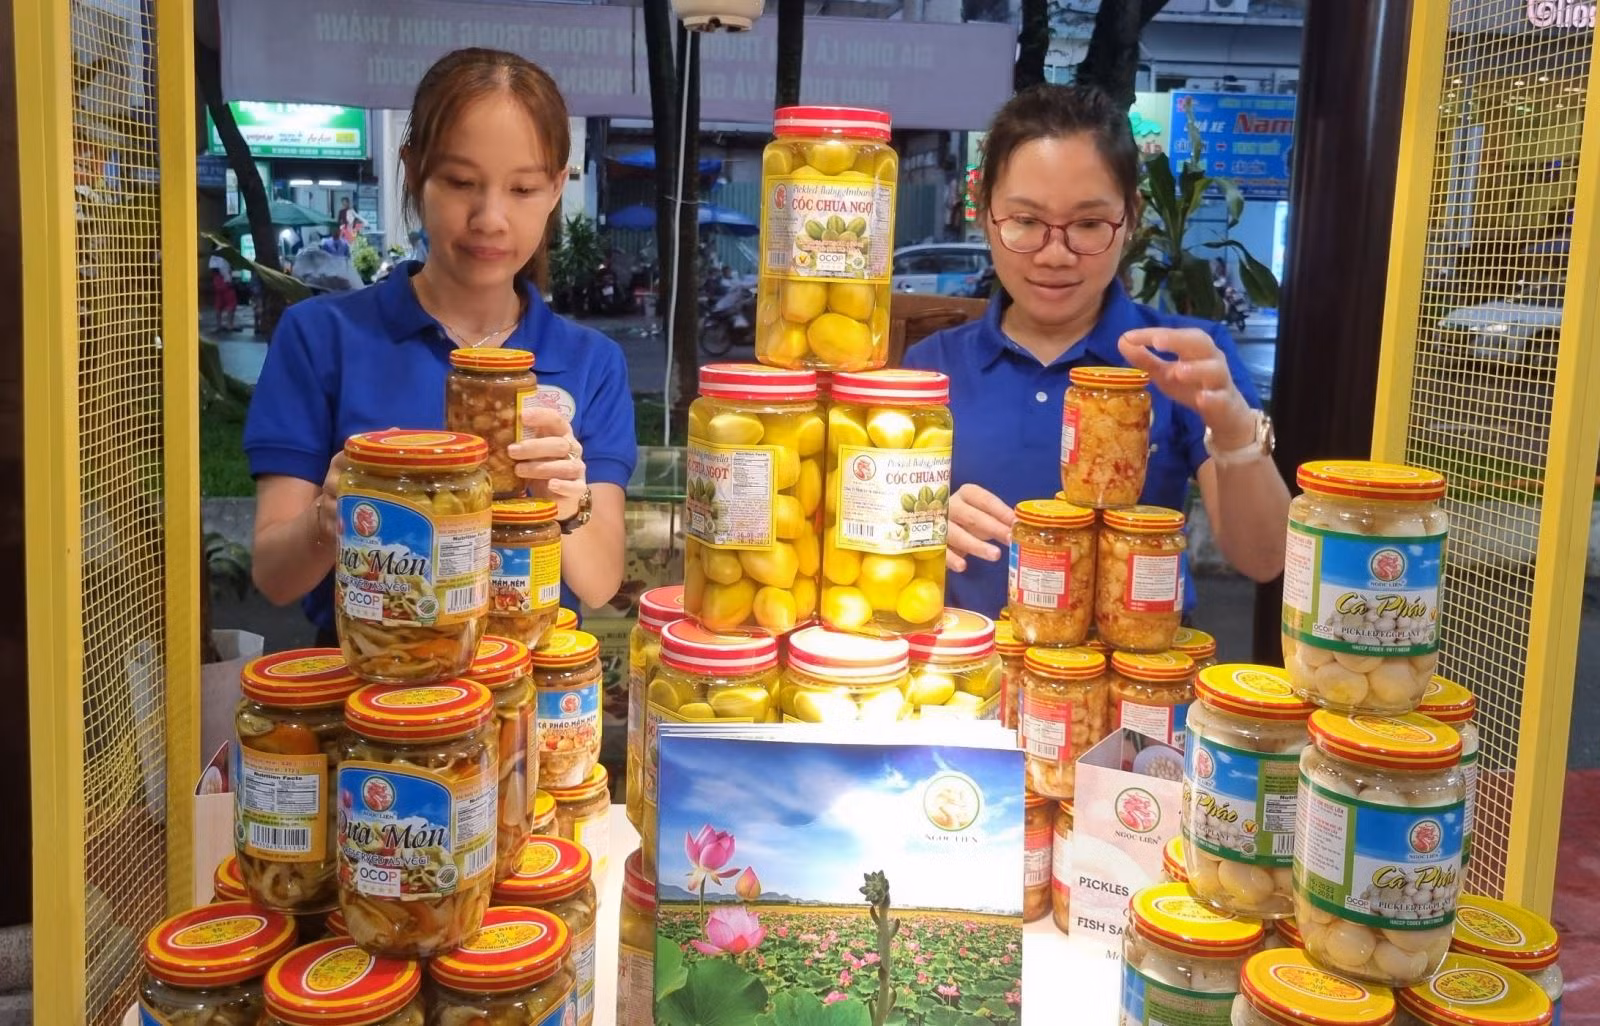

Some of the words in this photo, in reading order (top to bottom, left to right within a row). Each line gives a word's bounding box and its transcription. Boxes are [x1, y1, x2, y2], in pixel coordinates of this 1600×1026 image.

[367, 549, 426, 577] Món
[349, 590, 380, 606] OCOP
[1335, 592, 1369, 616] Cà
[381, 823, 444, 849] Món
[1115, 830, 1138, 841] NGỌC
[360, 867, 398, 882] OCOP
[1372, 865, 1409, 889] Cà
[1079, 876, 1129, 897] PICKLES
[1346, 896, 1369, 906] OCOP
[1077, 916, 1105, 932] FISH
